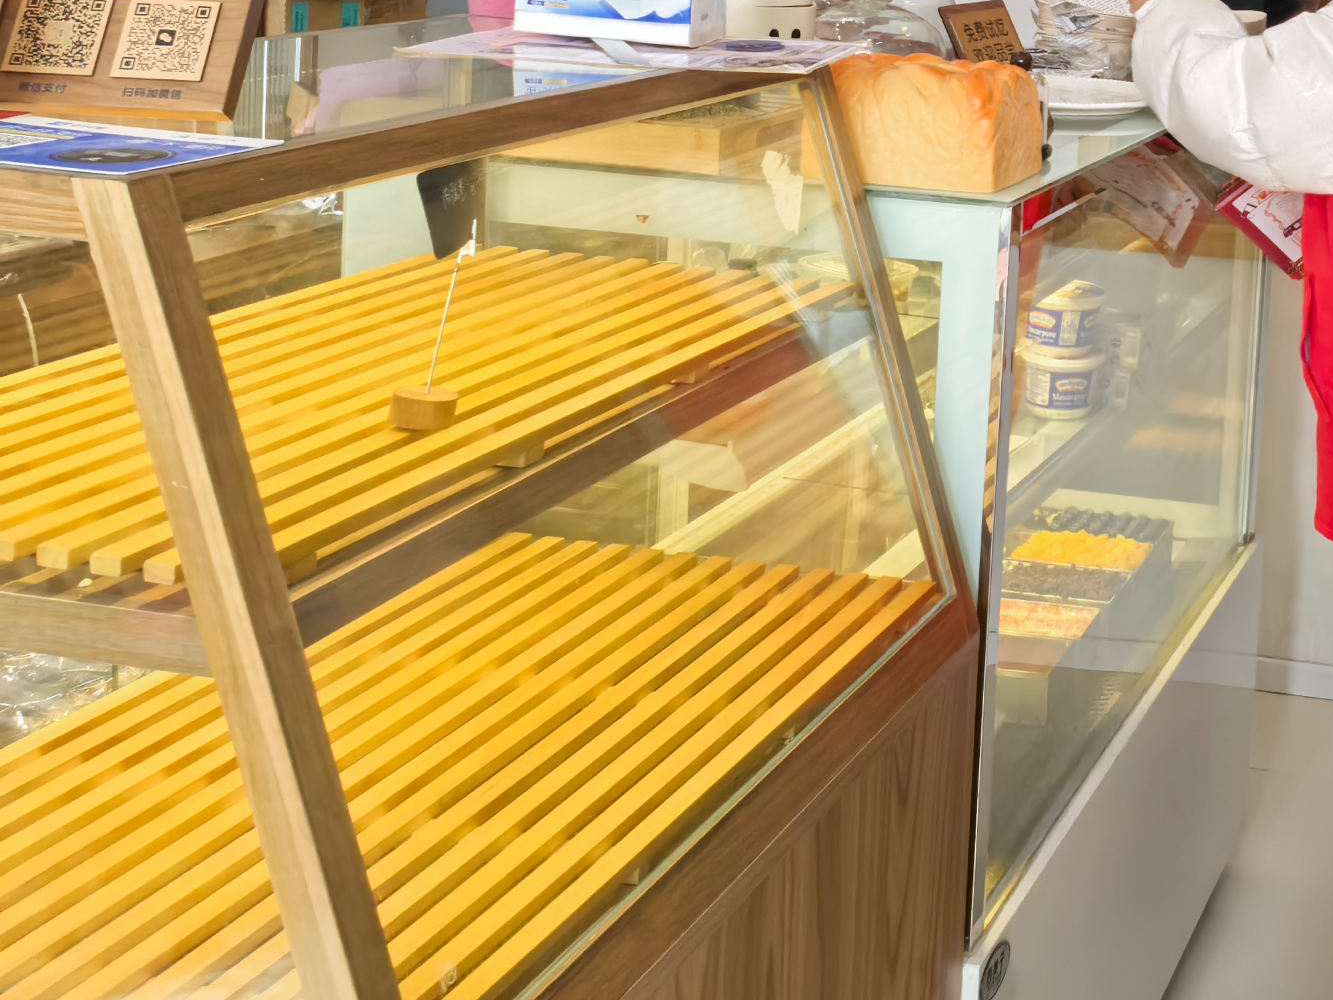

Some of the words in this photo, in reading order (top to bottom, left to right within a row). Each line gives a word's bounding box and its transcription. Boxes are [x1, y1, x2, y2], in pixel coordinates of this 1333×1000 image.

[963, 19, 1009, 43] 免费试吃
[18, 81, 67, 94] 微信支付
[121, 87, 183, 100] 扫码加微信
